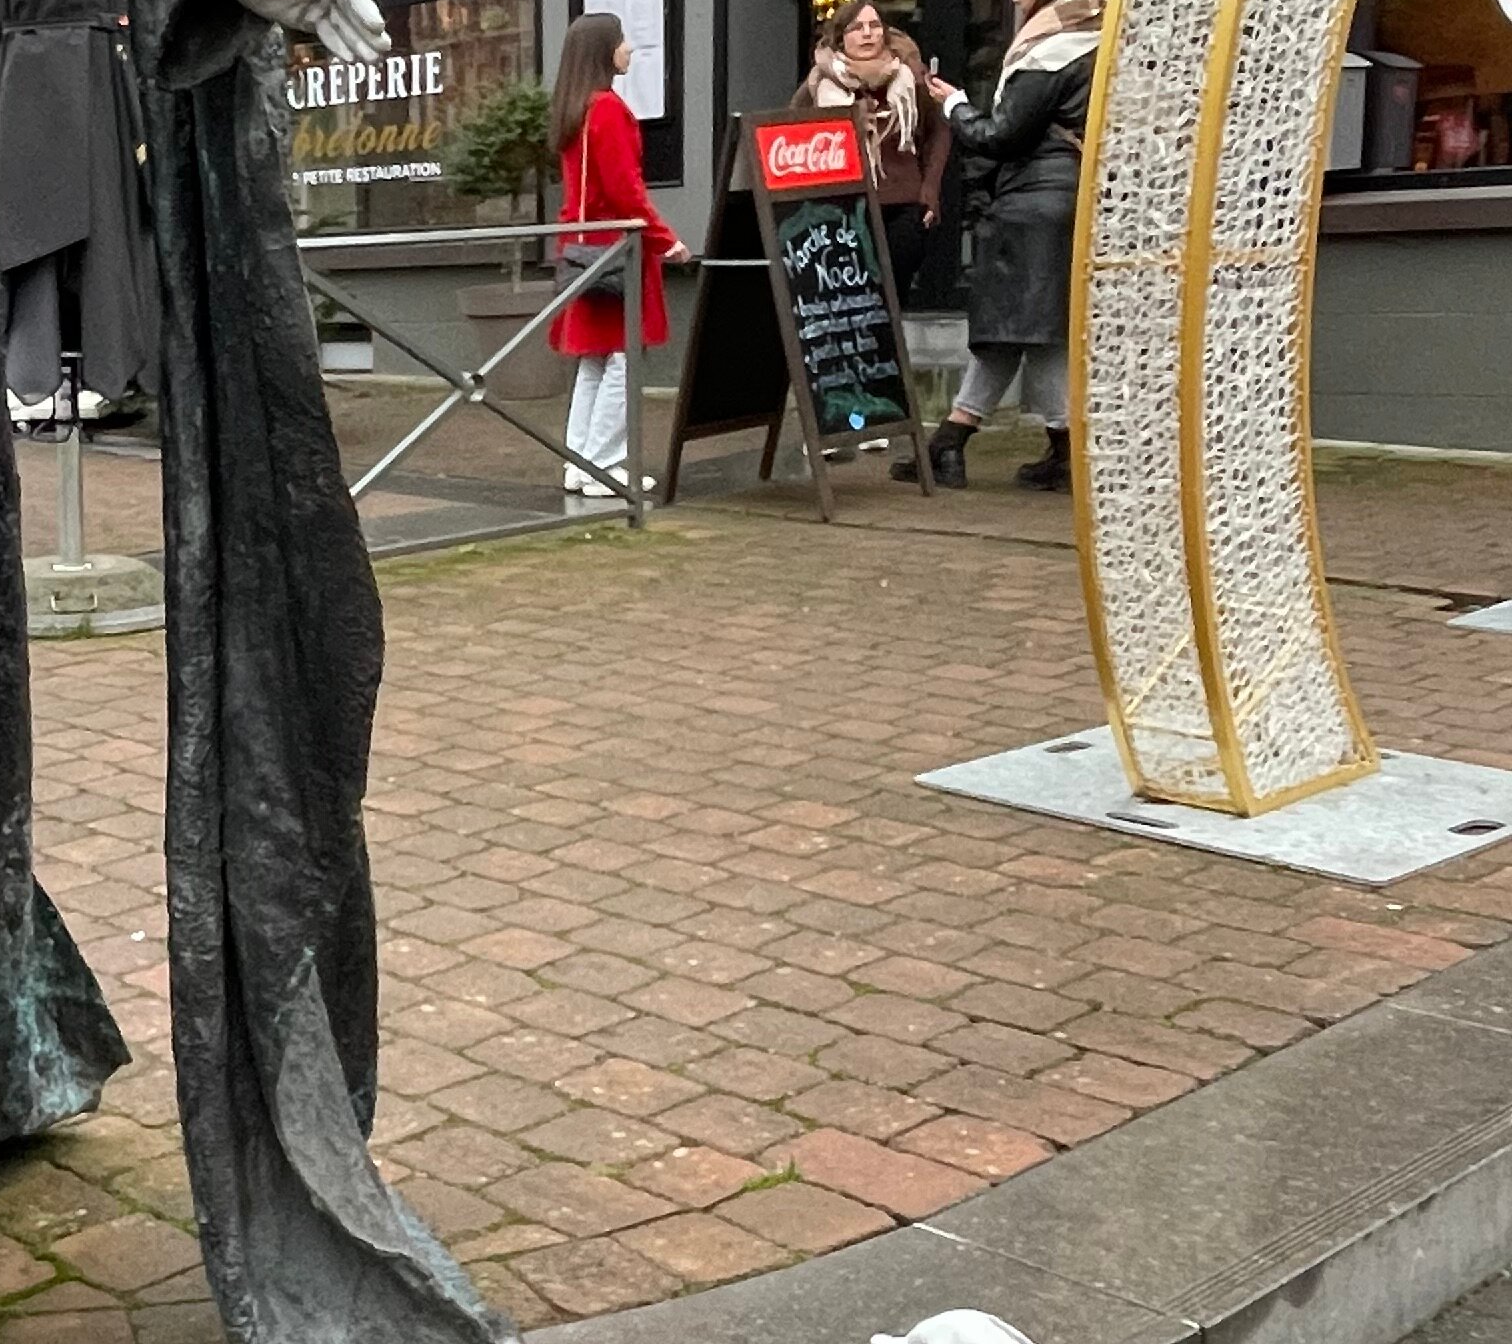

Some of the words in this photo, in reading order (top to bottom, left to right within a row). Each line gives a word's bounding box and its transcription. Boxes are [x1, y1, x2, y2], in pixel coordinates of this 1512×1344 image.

[303, 168, 343, 185] PETITE
[346, 162, 442, 183] RESTAURATION
[836, 214, 857, 248] de
[815, 247, 868, 293] Noël
